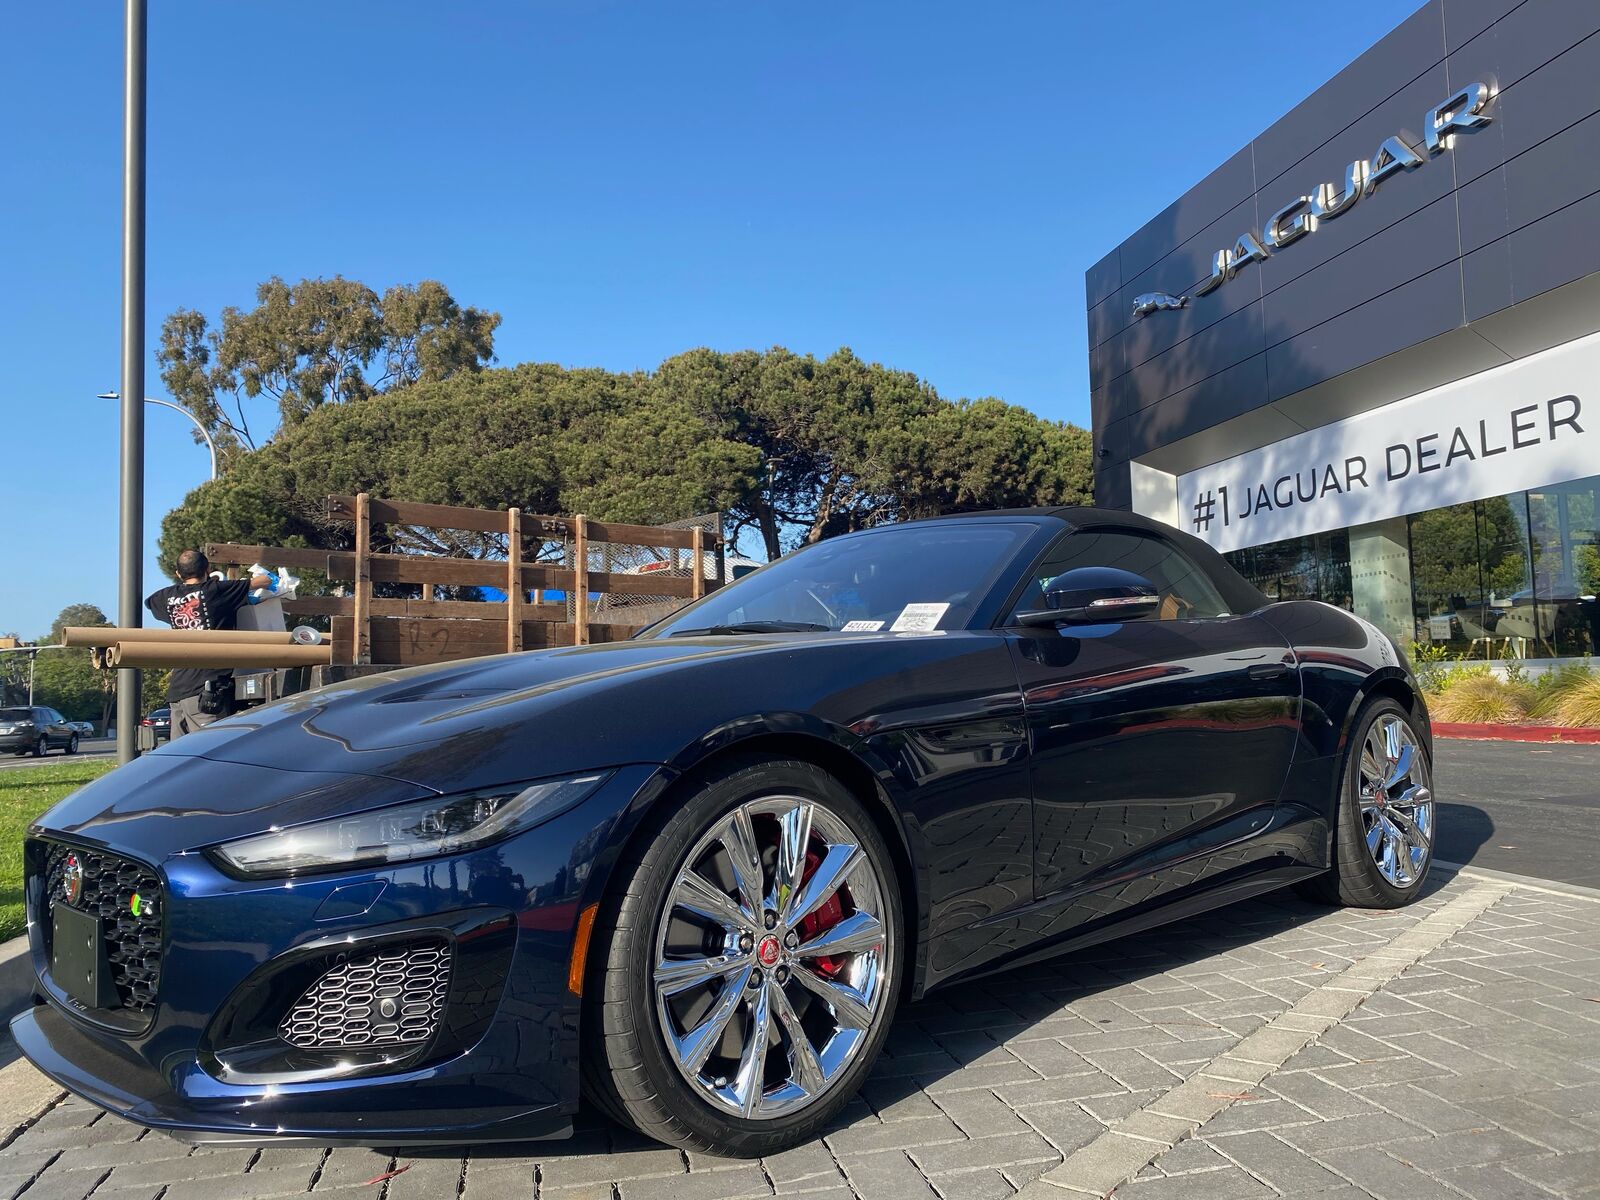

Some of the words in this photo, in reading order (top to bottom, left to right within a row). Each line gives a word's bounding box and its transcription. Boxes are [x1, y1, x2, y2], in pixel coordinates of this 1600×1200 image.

[1195, 80, 1497, 297] JAGUAR
[1193, 485, 1230, 533] #1
[1239, 455, 1369, 519] JAGUAR
[1384, 394, 1585, 482] DEALER
